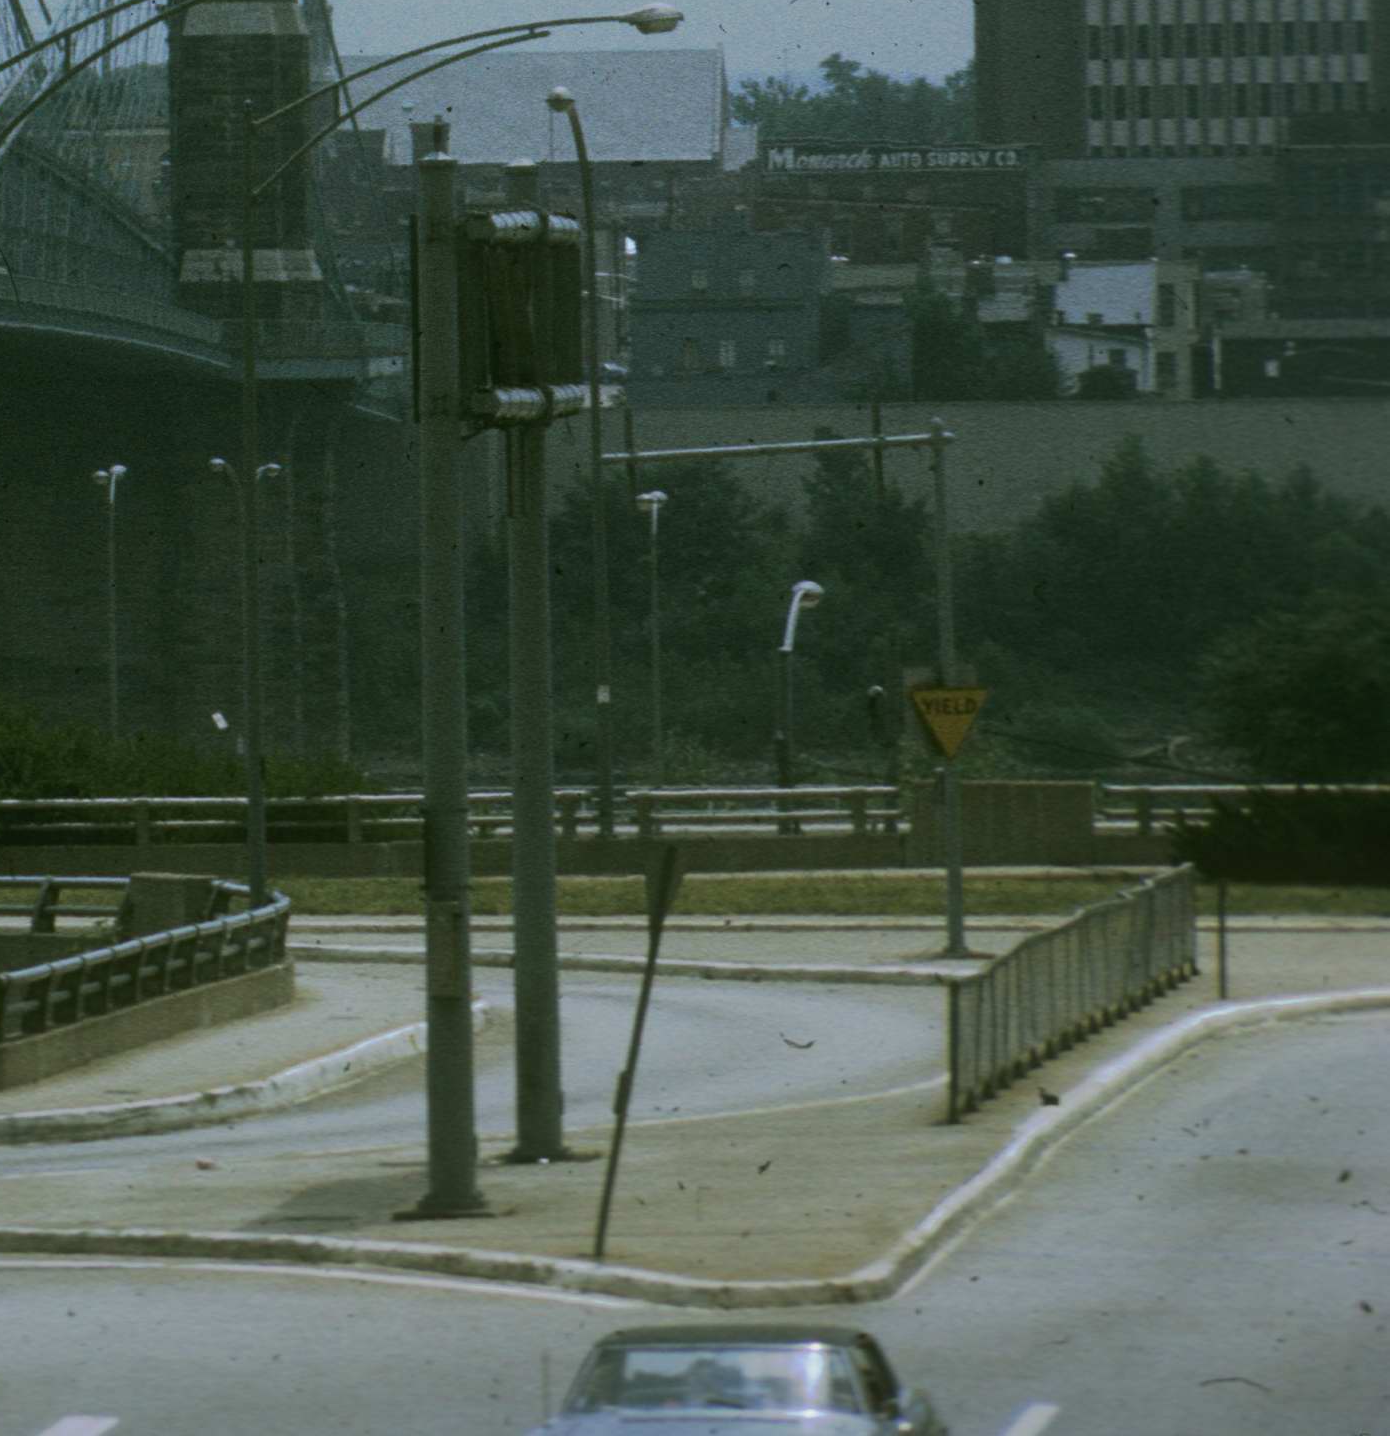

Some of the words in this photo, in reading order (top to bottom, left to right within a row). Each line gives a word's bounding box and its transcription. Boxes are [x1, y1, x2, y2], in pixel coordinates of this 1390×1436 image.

[879, 151, 921, 168] AUTO
[926, 151, 989, 168] SUPPLY
[921, 697, 977, 715] YIELD
